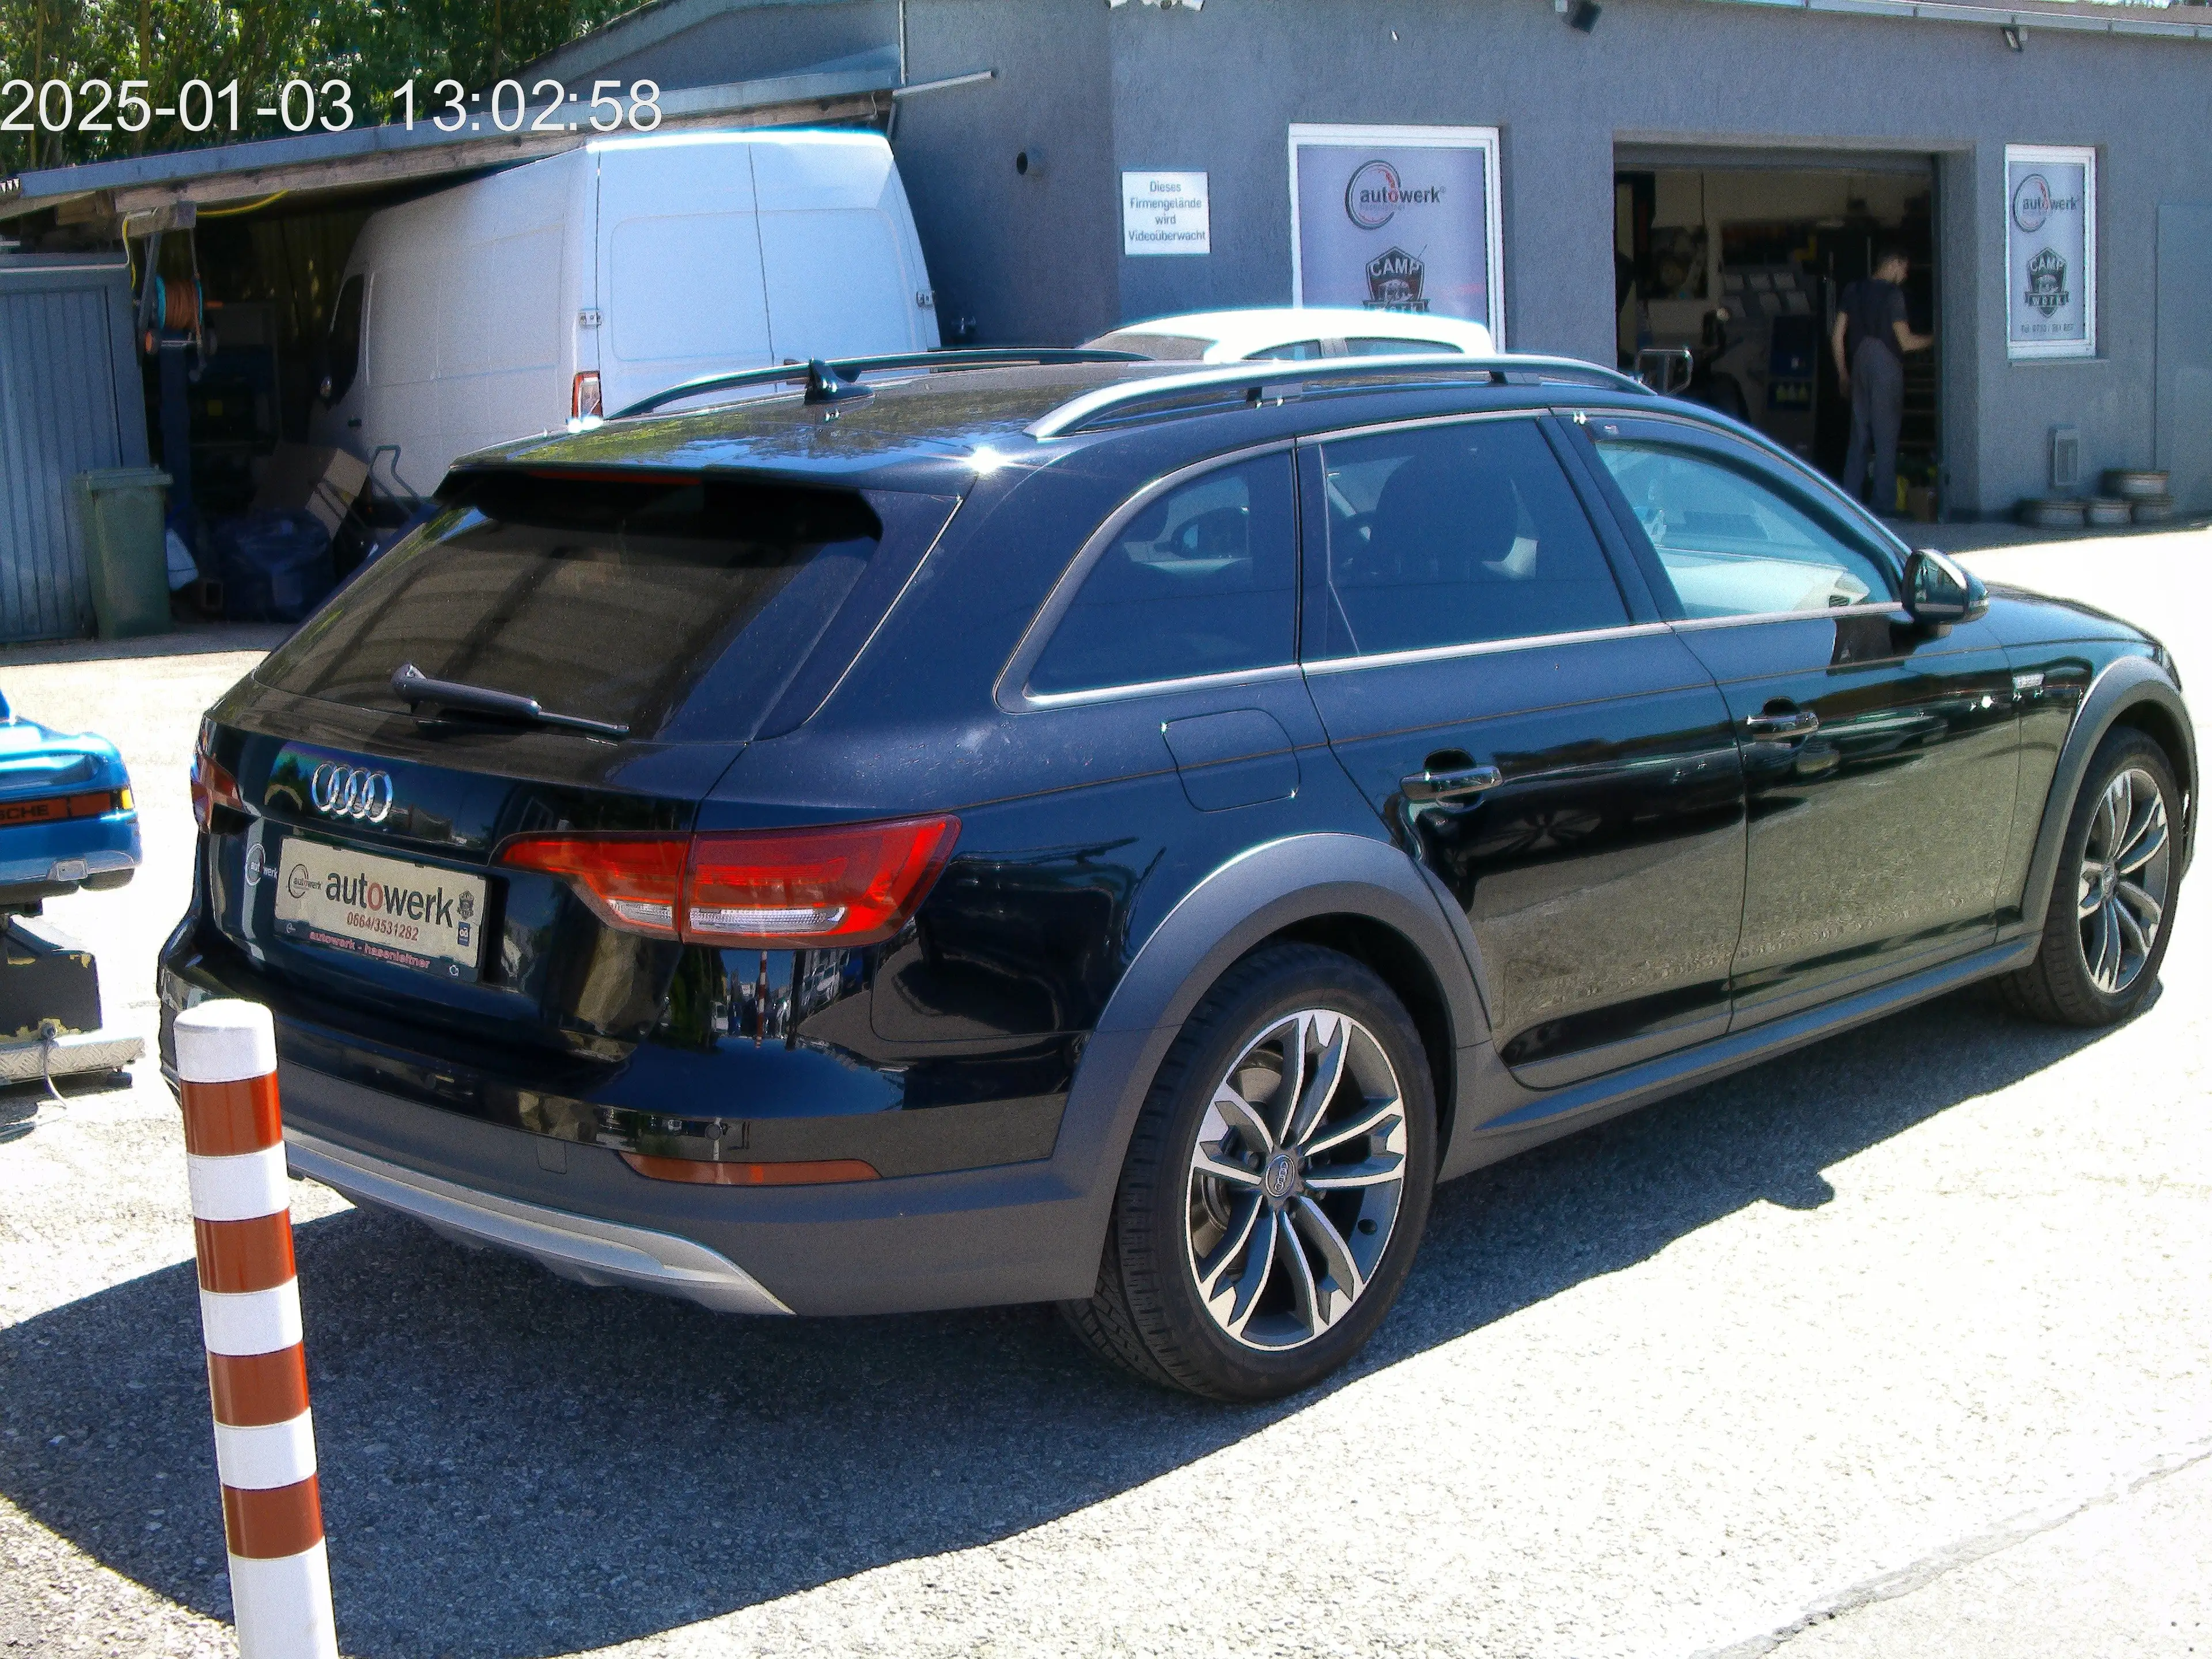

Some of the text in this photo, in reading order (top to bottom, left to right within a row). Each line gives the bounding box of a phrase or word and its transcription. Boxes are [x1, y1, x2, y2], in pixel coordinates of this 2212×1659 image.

[1149, 180, 1181, 192] Dieses
[1130, 196, 1202, 211] Firmengelände
[1154, 213, 1177, 225] wird
[1371, 257, 1420, 276] CAMP
[325, 872, 454, 927] autowerk
[346, 911, 419, 941] 0664/3531282
